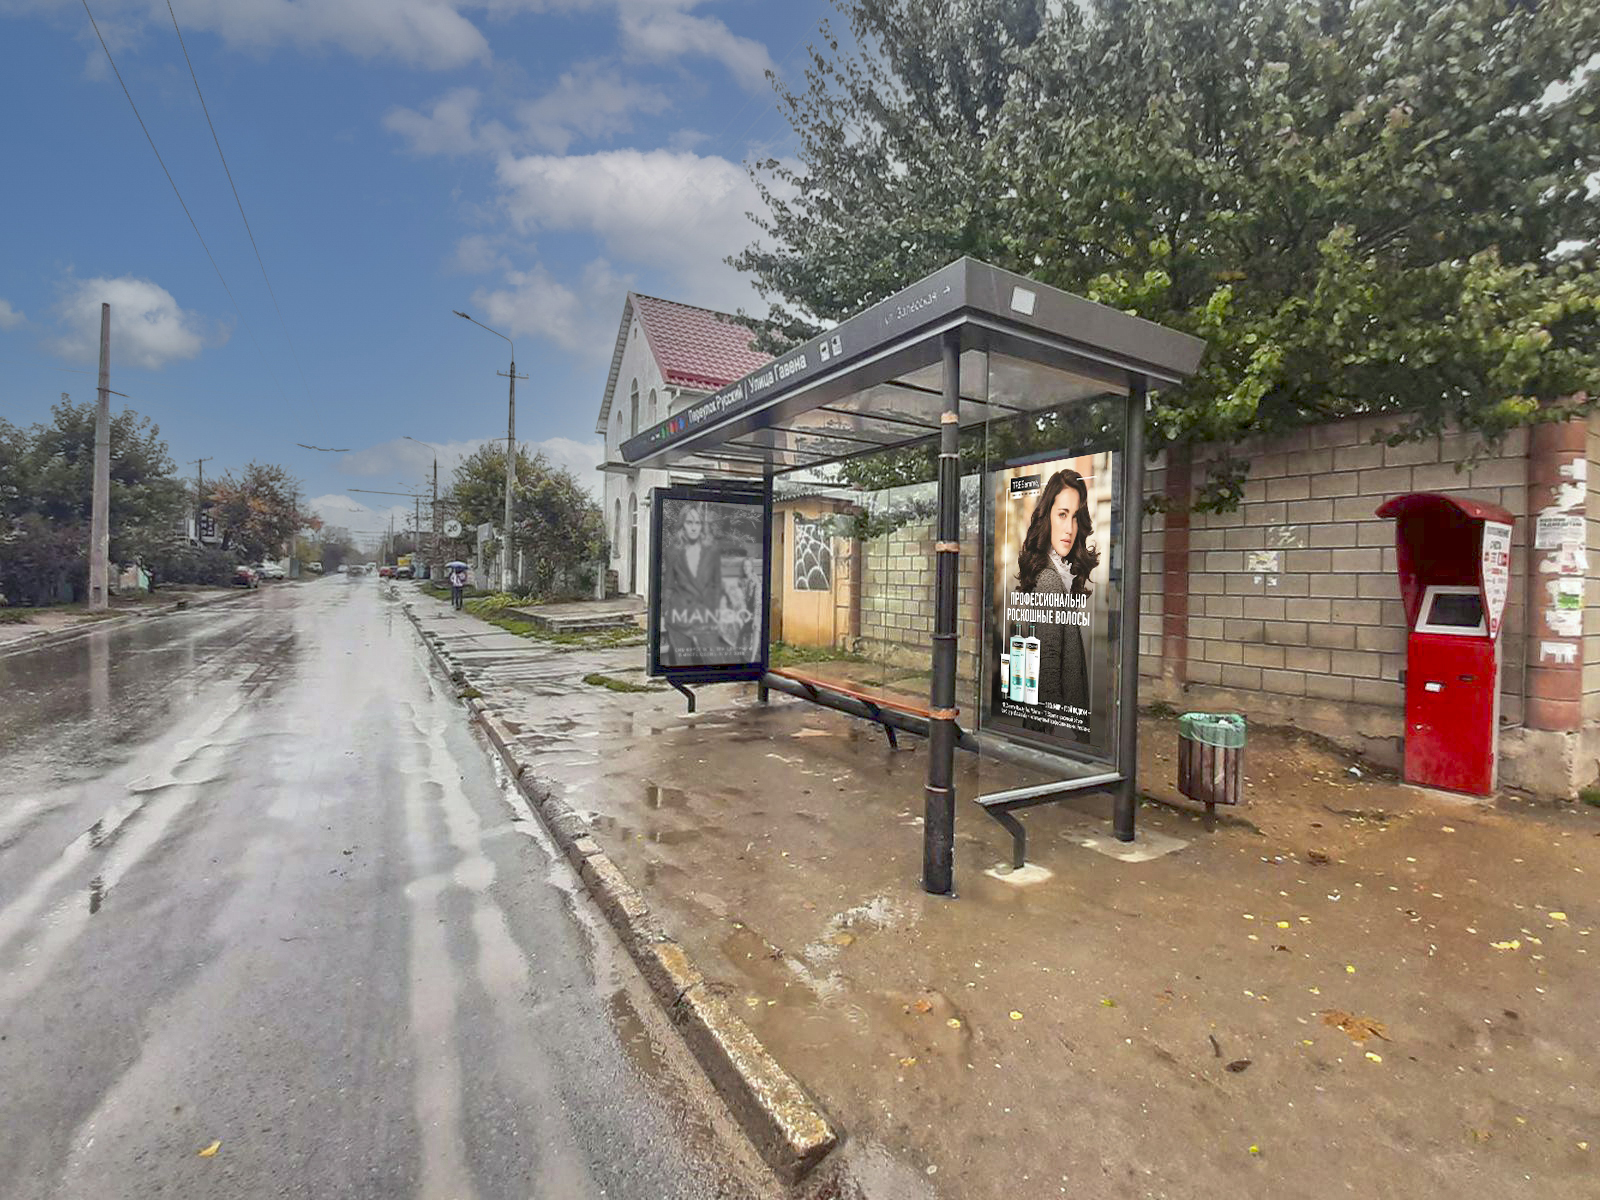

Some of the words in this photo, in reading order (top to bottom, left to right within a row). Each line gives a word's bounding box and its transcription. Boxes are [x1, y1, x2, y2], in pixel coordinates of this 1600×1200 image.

[715, 384, 744, 411] Русский
[748, 370, 774, 393] Улица
[773, 354, 807, 381] Гавена
[448, 524, 458, 532] 20
[1010, 591, 1087, 609] ПРОФЕССИОНАЛЬНО
[1007, 608, 1053, 624] РОСКОШНЫЕ
[1055, 610, 1090, 627] ВОЛОСЫ
